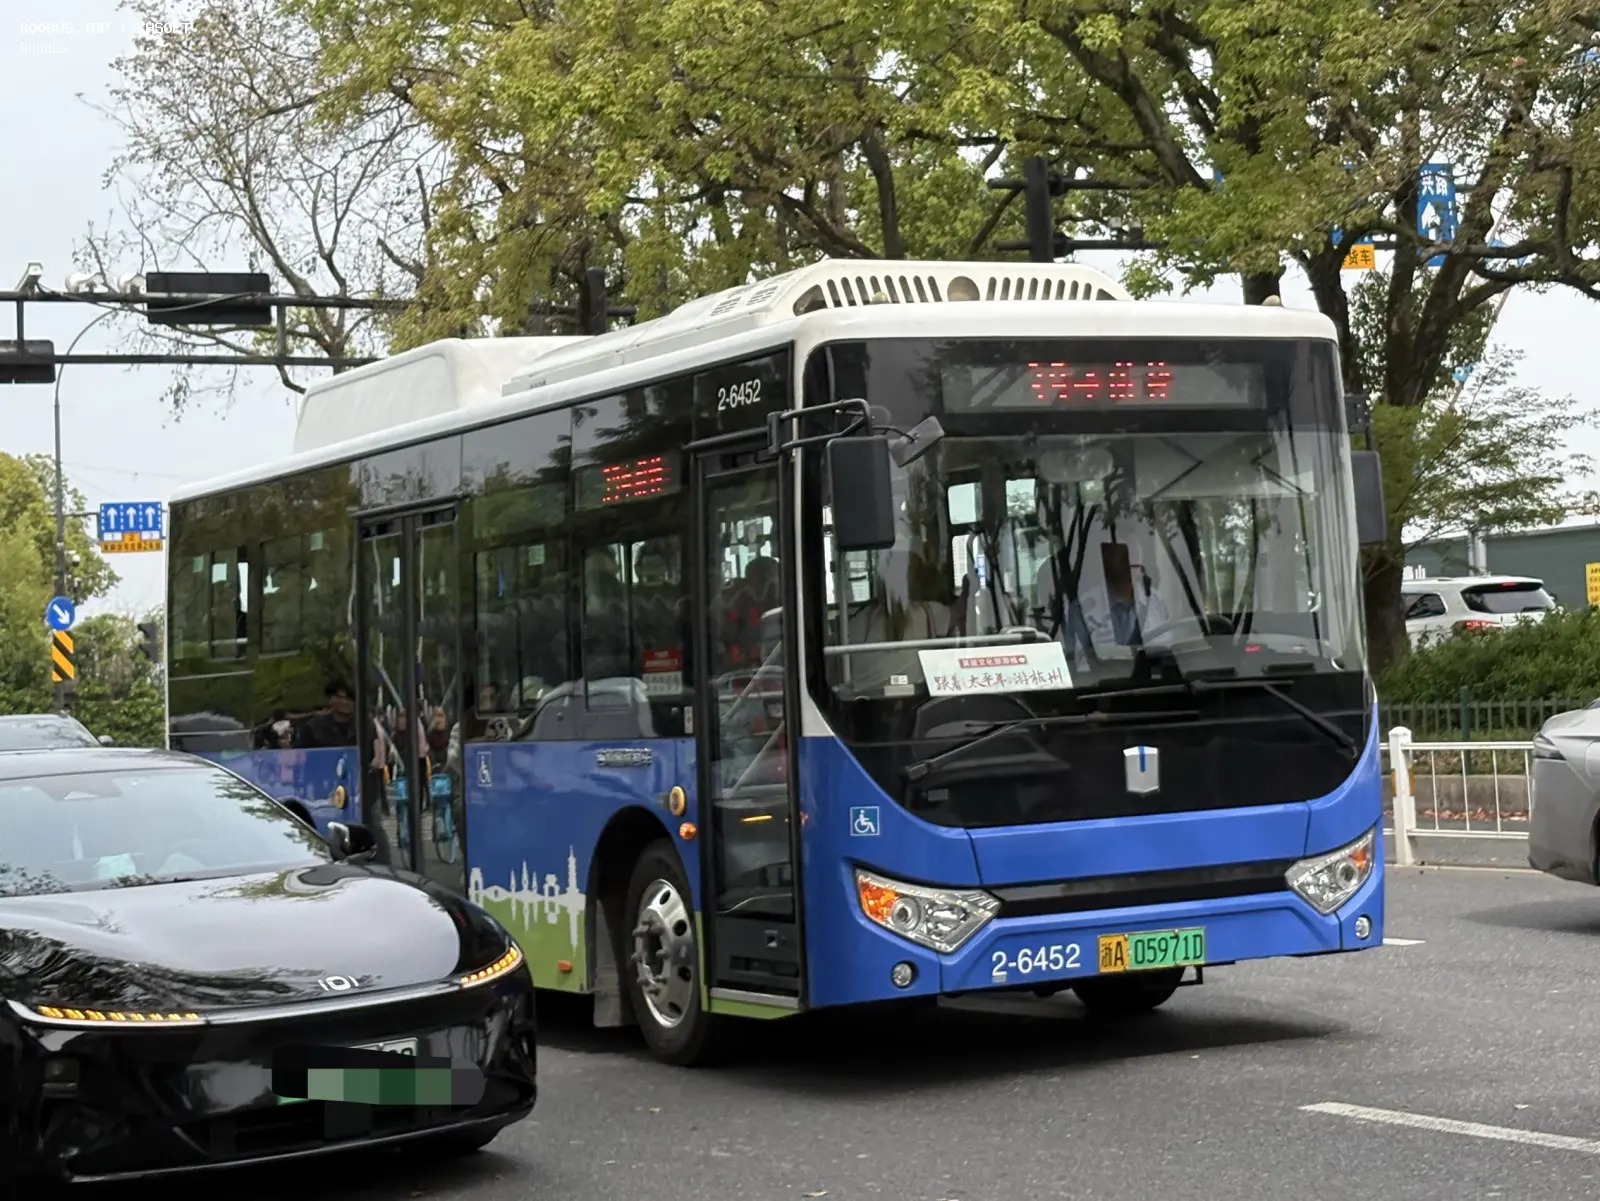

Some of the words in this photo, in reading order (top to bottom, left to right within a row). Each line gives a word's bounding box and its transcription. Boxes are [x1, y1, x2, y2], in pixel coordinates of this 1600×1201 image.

[1341, 249, 1371, 266] 货车
[718, 378, 761, 411] 2-6452
[991, 943, 1081, 976] 2-6452
